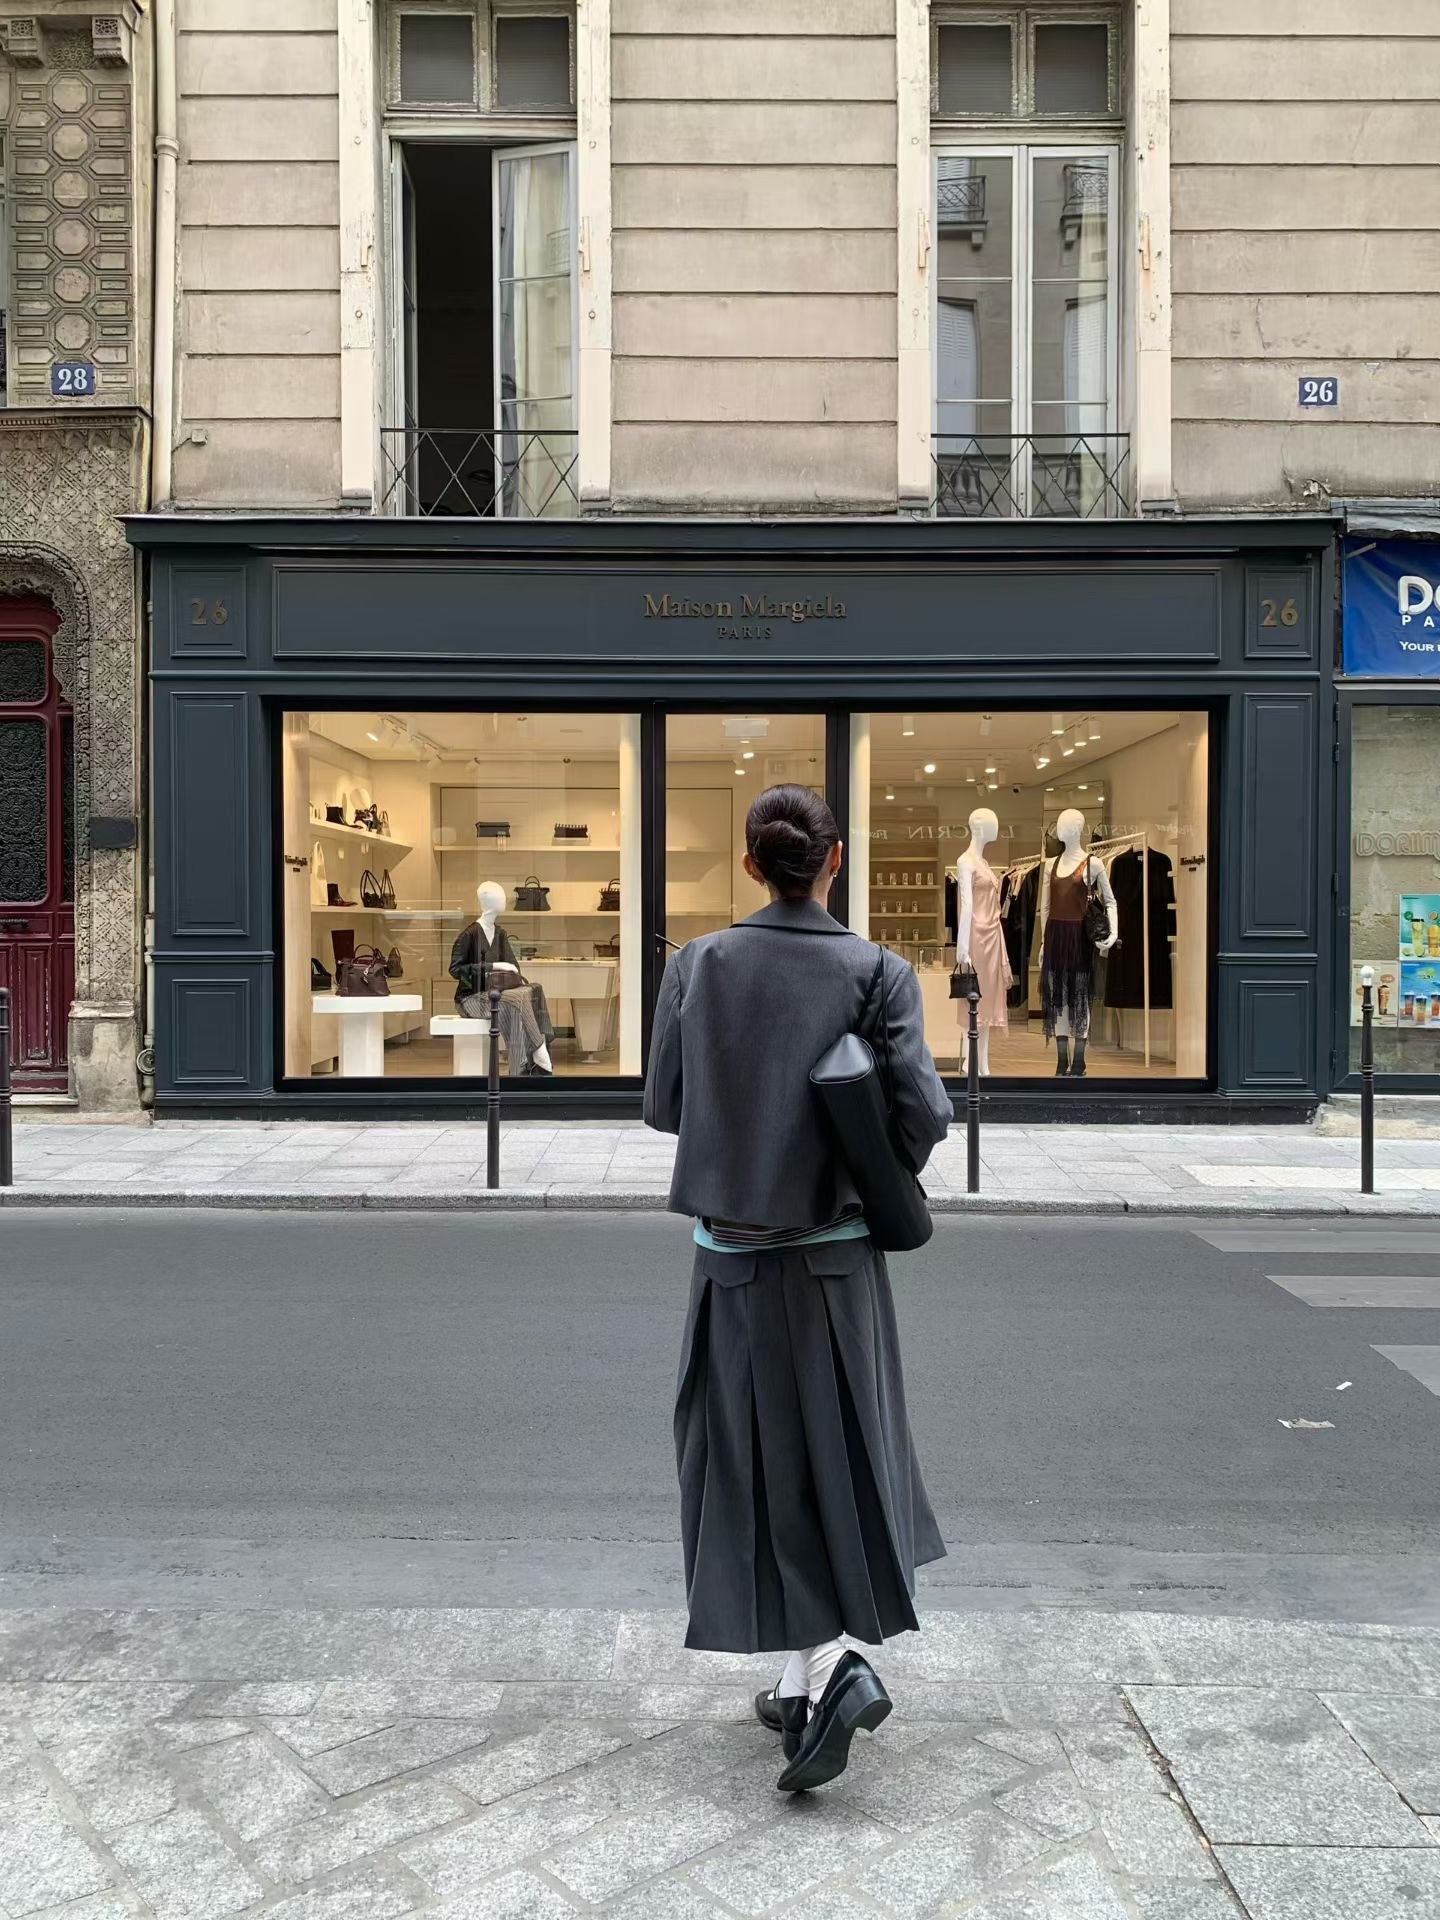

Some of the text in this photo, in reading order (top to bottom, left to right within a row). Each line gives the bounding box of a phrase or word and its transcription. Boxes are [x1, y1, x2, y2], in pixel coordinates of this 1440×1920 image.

[58, 368, 88, 391] 28
[1303, 380, 1333, 403] 26
[643, 592, 847, 623] Maison Margiela
[1398, 576, 1440, 615] D
[191, 597, 229, 625] 26
[1260, 598, 1299, 627] 26
[717, 625, 773, 639] PARIS
[1400, 641, 1435, 652] YOUR
